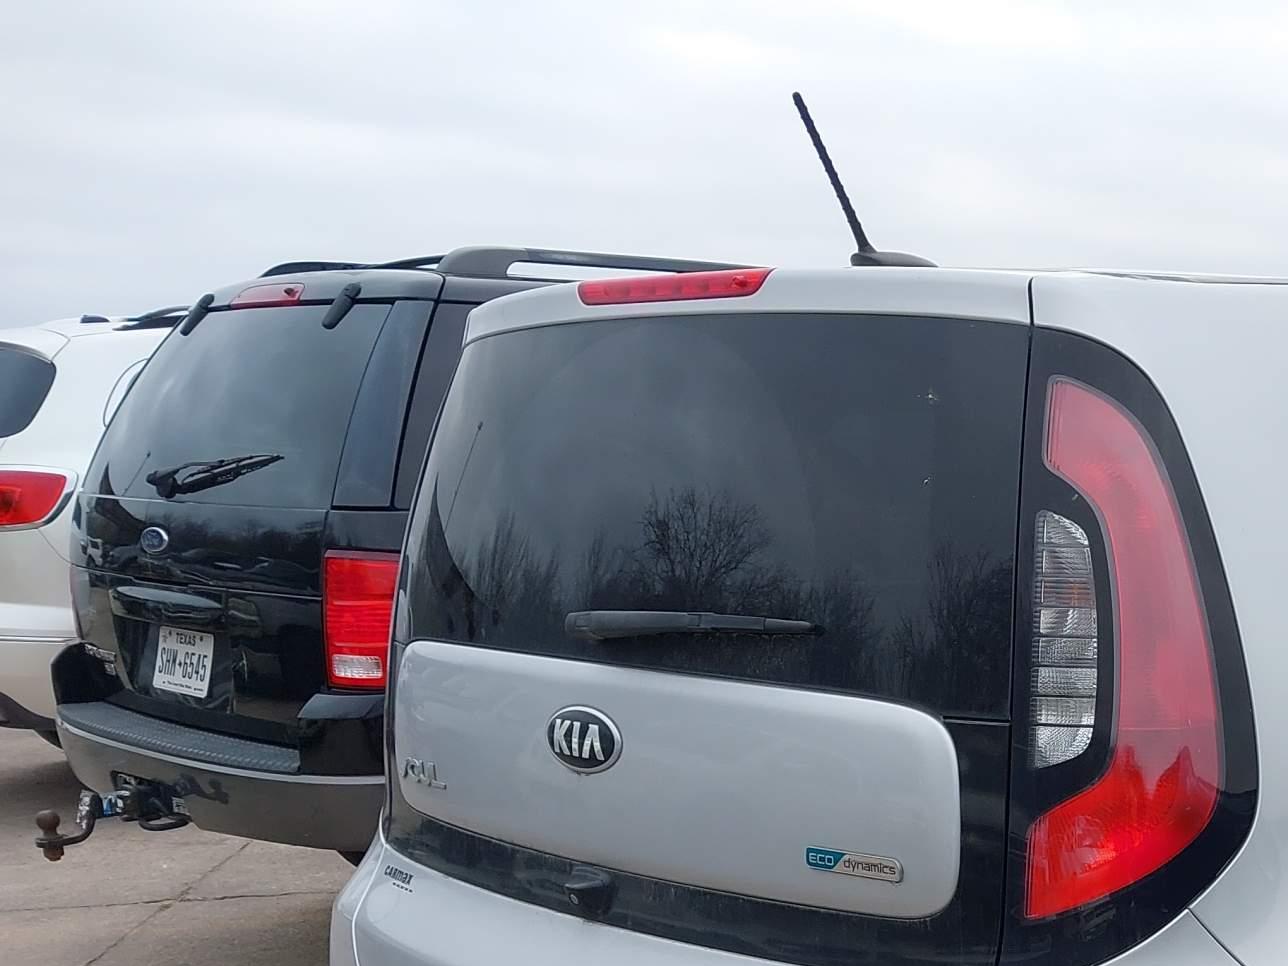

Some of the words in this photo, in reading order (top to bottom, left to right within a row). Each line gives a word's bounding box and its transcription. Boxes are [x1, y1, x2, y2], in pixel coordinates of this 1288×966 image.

[175, 631, 196, 647] TEXAS
[553, 718, 605, 761] KIA
[808, 852, 834, 866] ECO
[843, 858, 897, 875] dynamics
